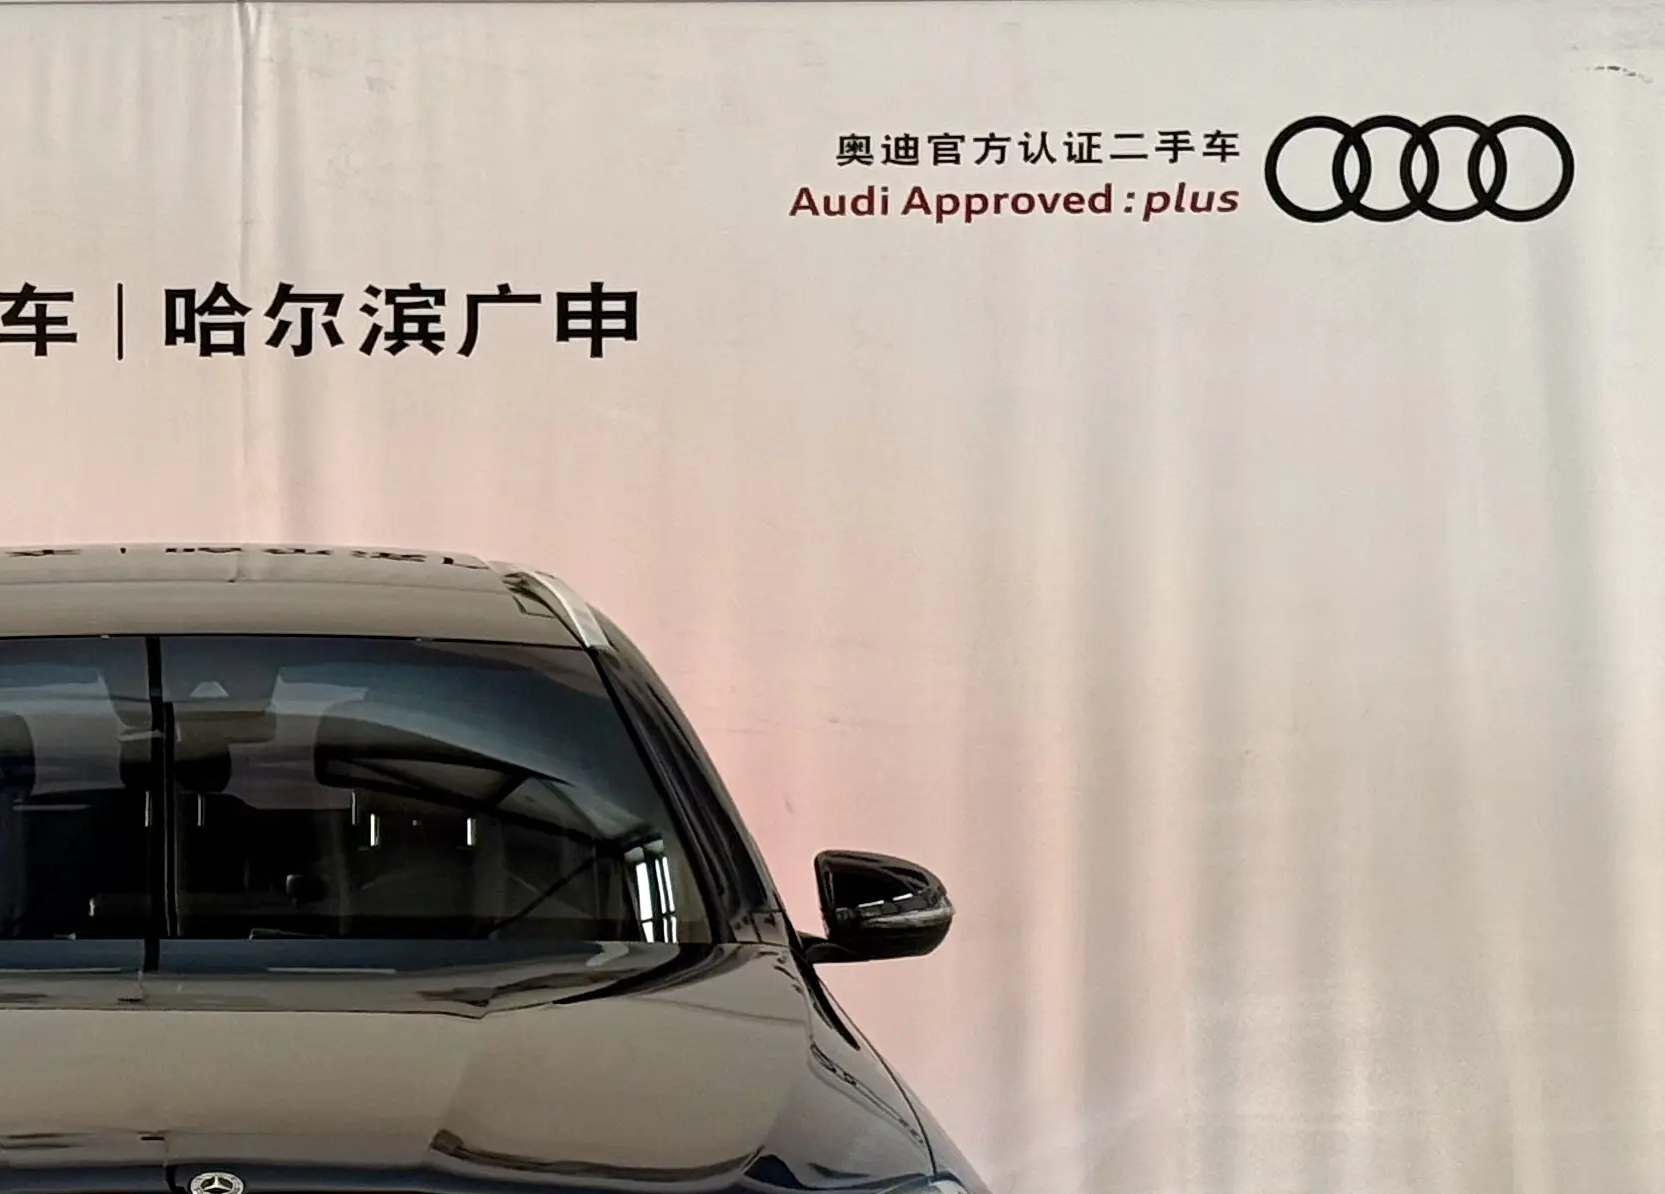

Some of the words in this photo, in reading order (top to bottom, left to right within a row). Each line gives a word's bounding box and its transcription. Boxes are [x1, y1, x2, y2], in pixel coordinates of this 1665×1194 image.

[835, 128, 1240, 167] 奥迪官方认证二手车
[789, 184, 890, 218] Audi
[164, 280, 638, 359] 哈尔滨广申
